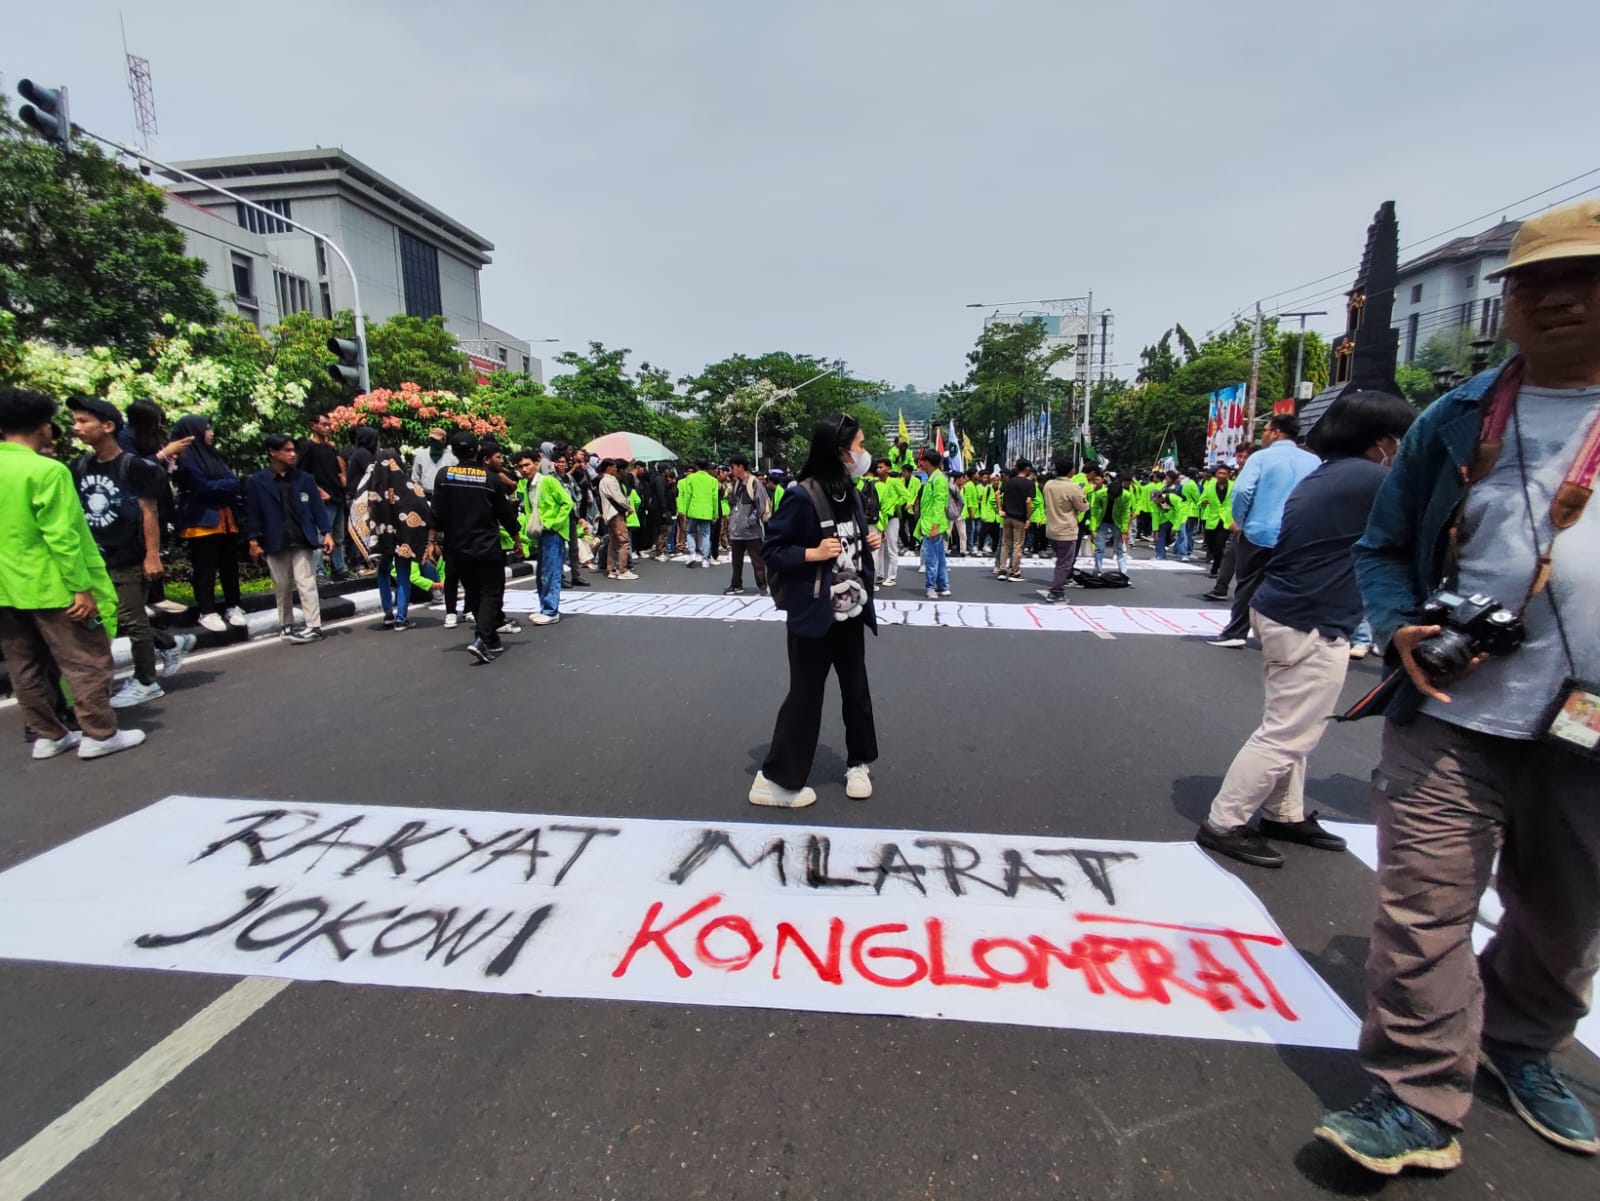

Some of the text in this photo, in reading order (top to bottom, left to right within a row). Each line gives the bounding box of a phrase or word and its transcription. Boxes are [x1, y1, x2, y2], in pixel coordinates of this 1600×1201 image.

[190, 808, 620, 886] RAKYAT
[134, 886, 1300, 1021] JOKOWI KONGLOMERAT
